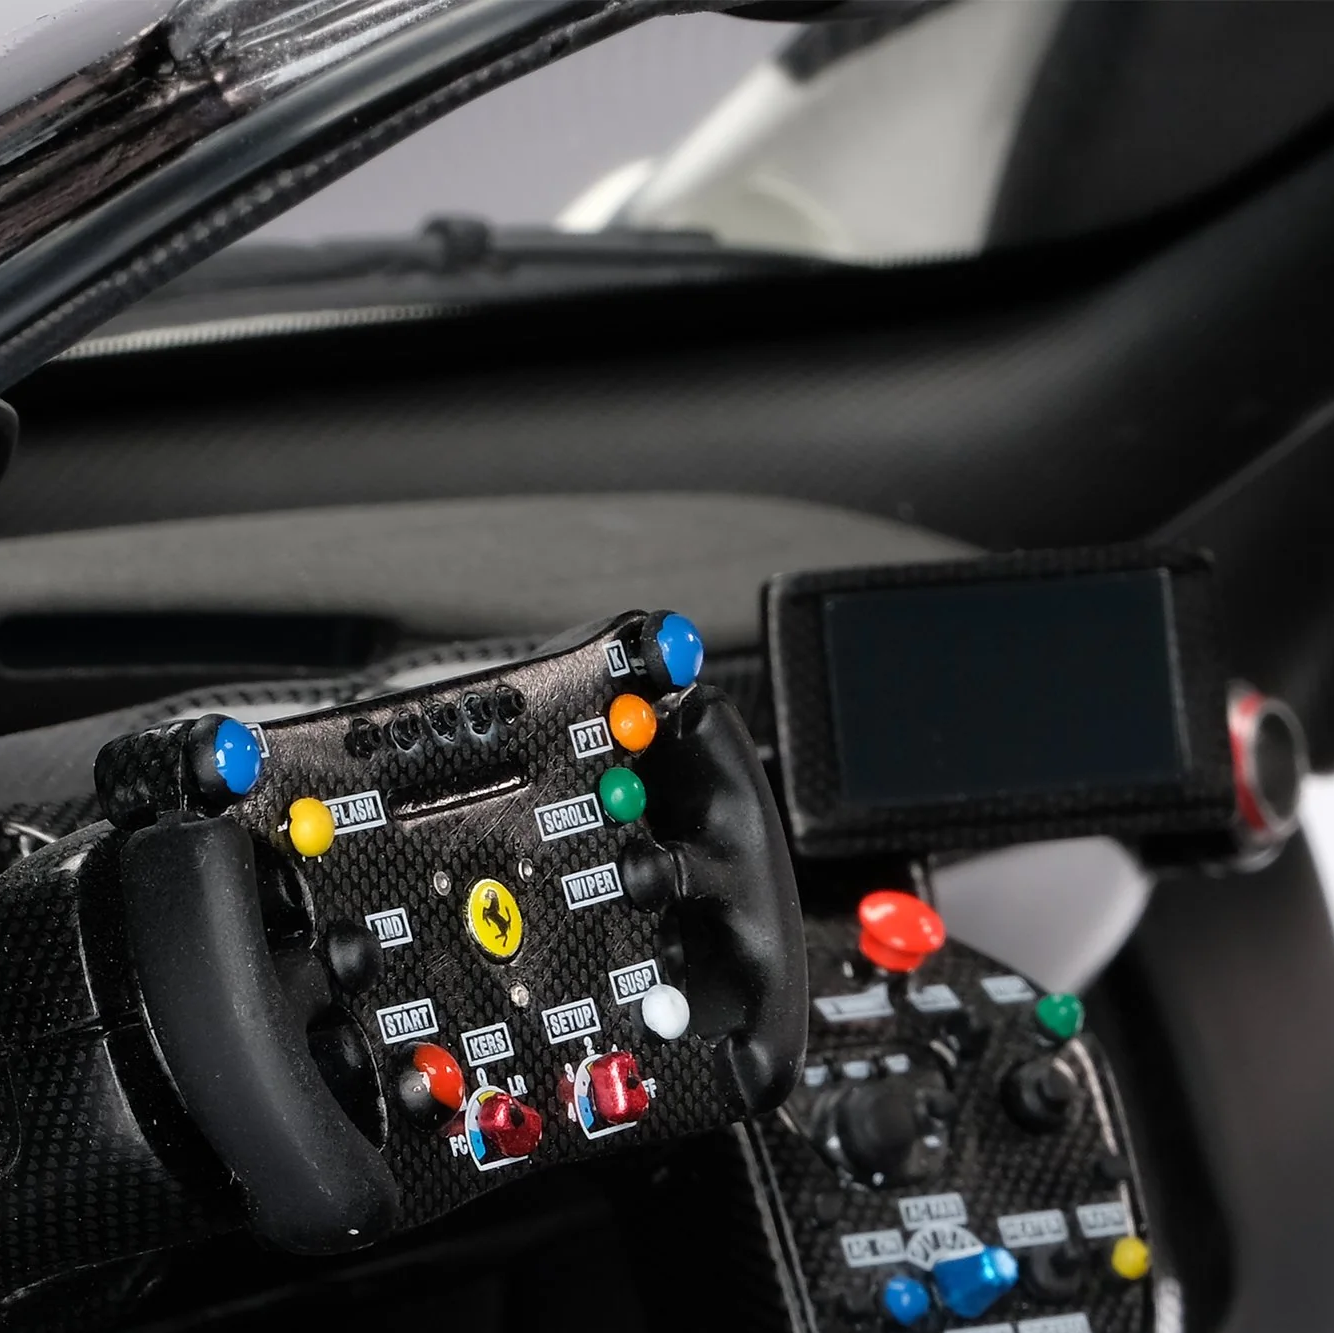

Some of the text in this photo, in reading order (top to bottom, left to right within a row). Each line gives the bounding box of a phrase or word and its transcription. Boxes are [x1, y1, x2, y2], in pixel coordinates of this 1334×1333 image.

[608, 647, 624, 669] K
[577, 725, 605, 750] PIT
[330, 798, 377, 827] FLASH
[543, 801, 596, 834] SCROLL
[568, 871, 616, 901] WIPER
[374, 916, 404, 940] IND
[617, 968, 652, 996] SUSP
[385, 1006, 430, 1036] START
[549, 1005, 593, 1036] SETUP
[469, 1031, 507, 1059] KERS
